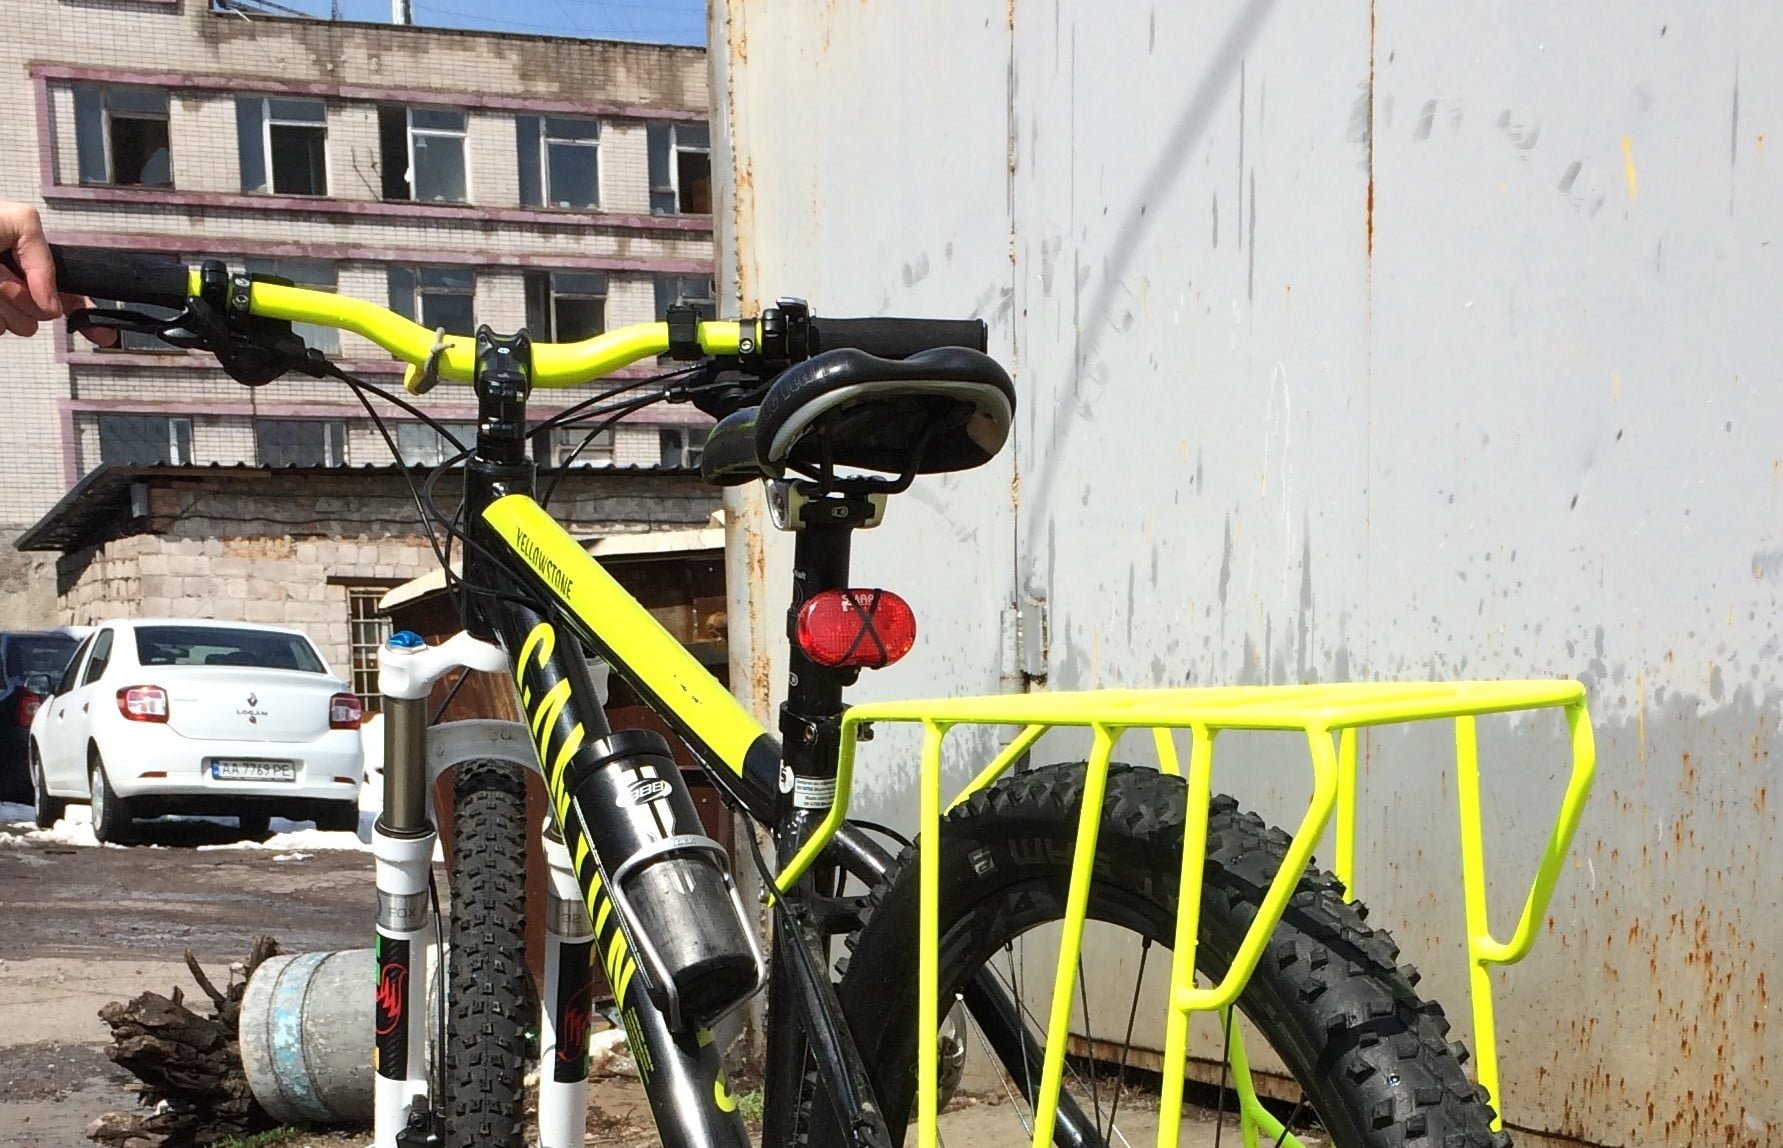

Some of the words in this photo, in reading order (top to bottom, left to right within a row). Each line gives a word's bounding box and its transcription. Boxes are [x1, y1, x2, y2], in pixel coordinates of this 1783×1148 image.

[516, 527, 574, 600] YELLOWSTONE
[222, 762, 240, 775] AA
[242, 762, 271, 776] 7769
[273, 763, 291, 777] PE
[388, 906, 417, 919] FOX
